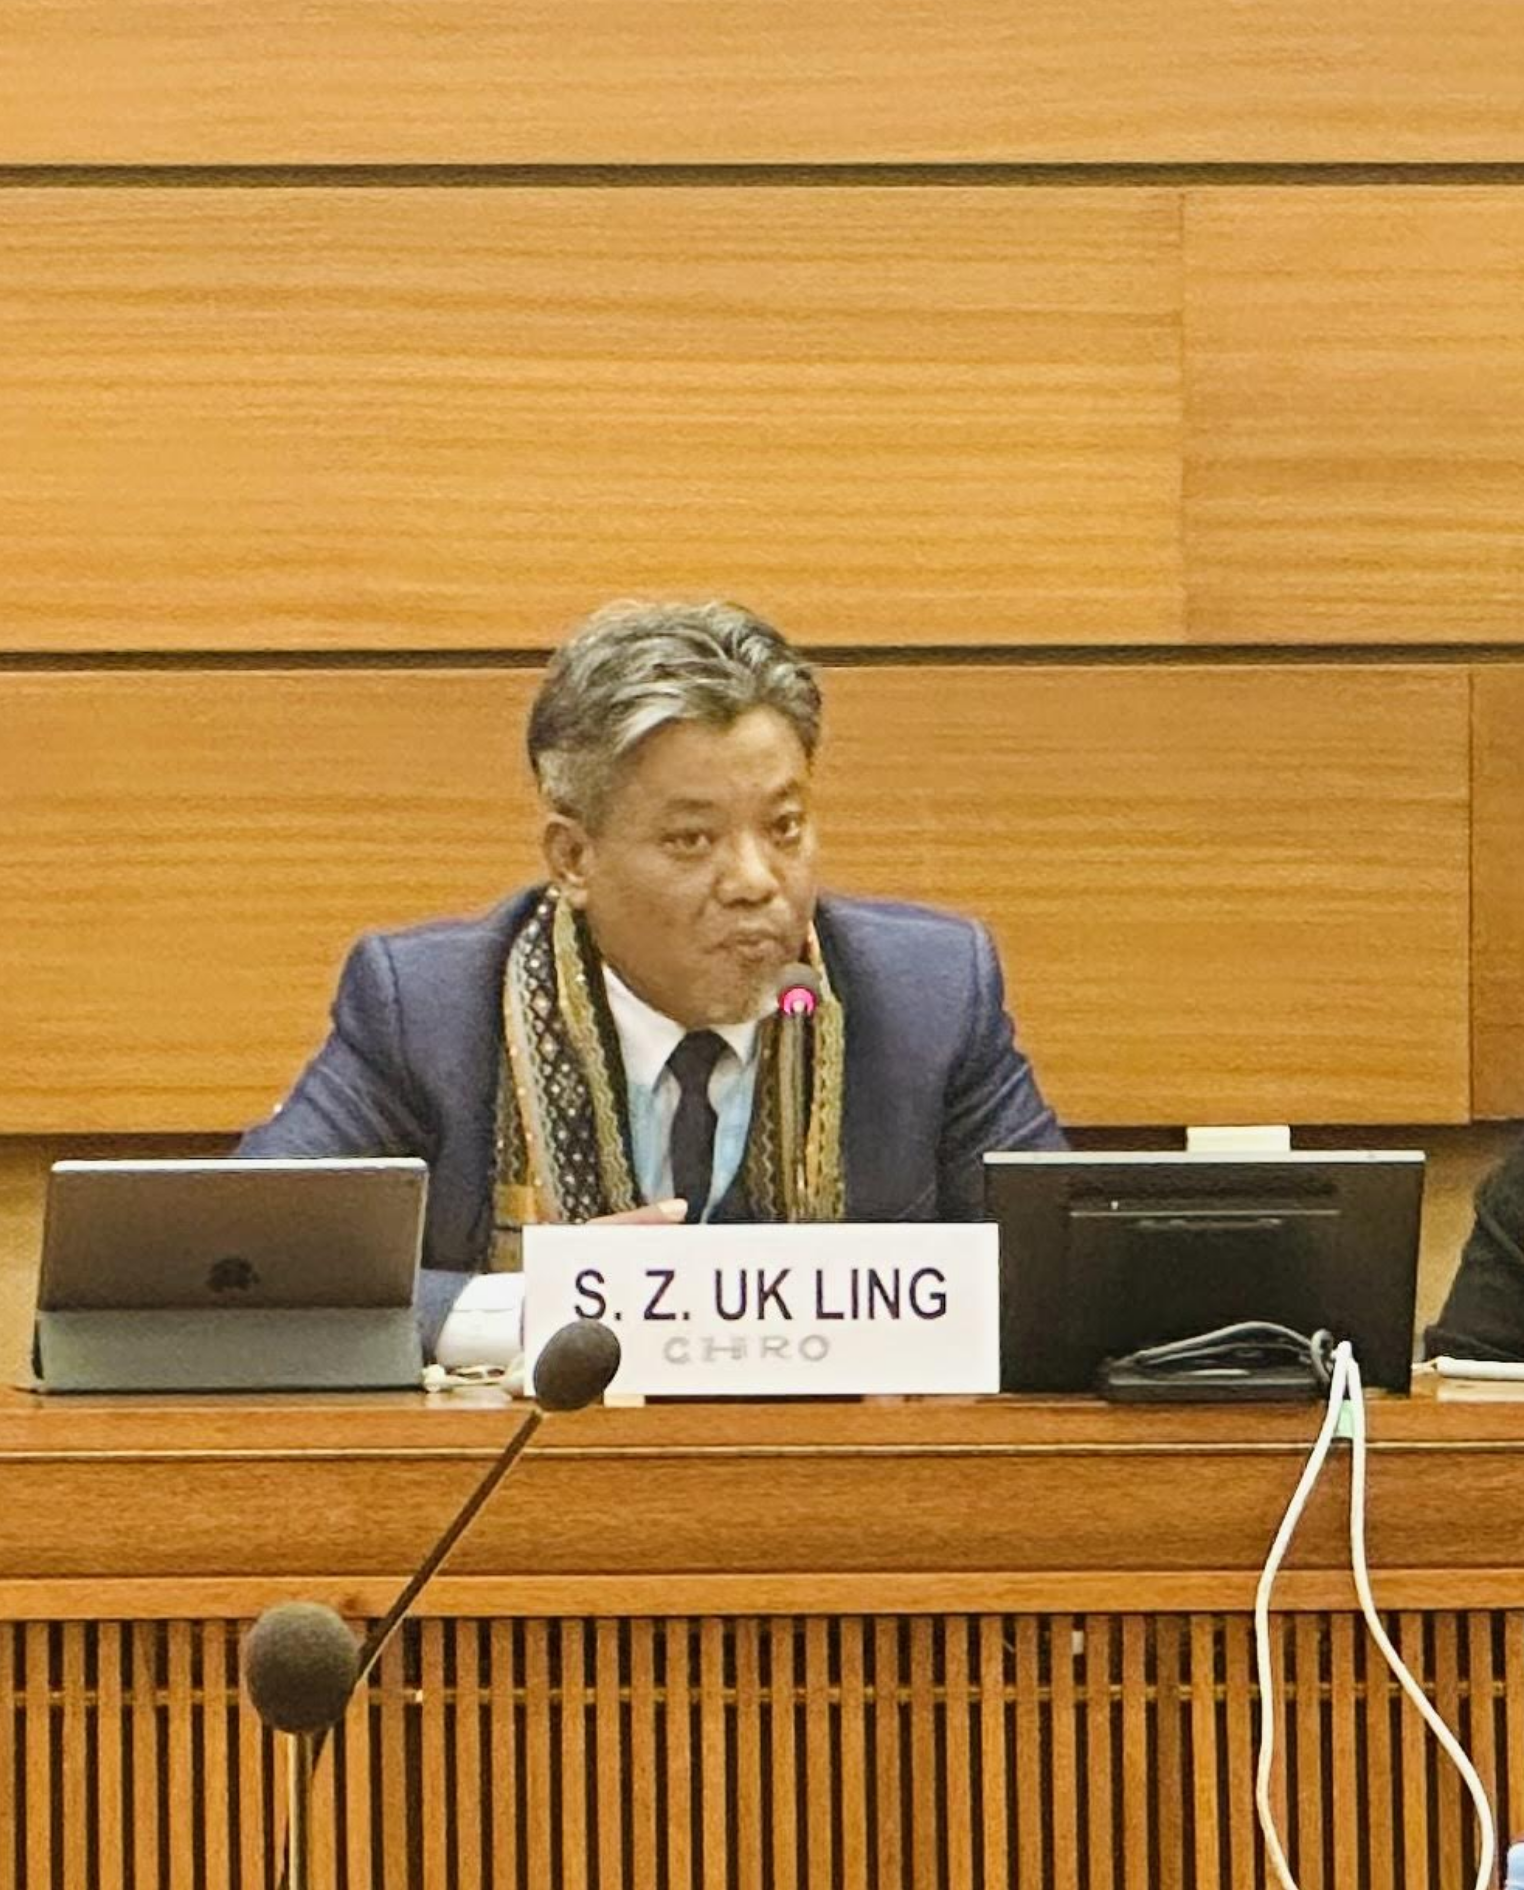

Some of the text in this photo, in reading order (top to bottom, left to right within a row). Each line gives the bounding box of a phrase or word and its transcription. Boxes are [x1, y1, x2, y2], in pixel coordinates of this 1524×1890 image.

[574, 1266, 948, 1321] S. Z. UK LING
